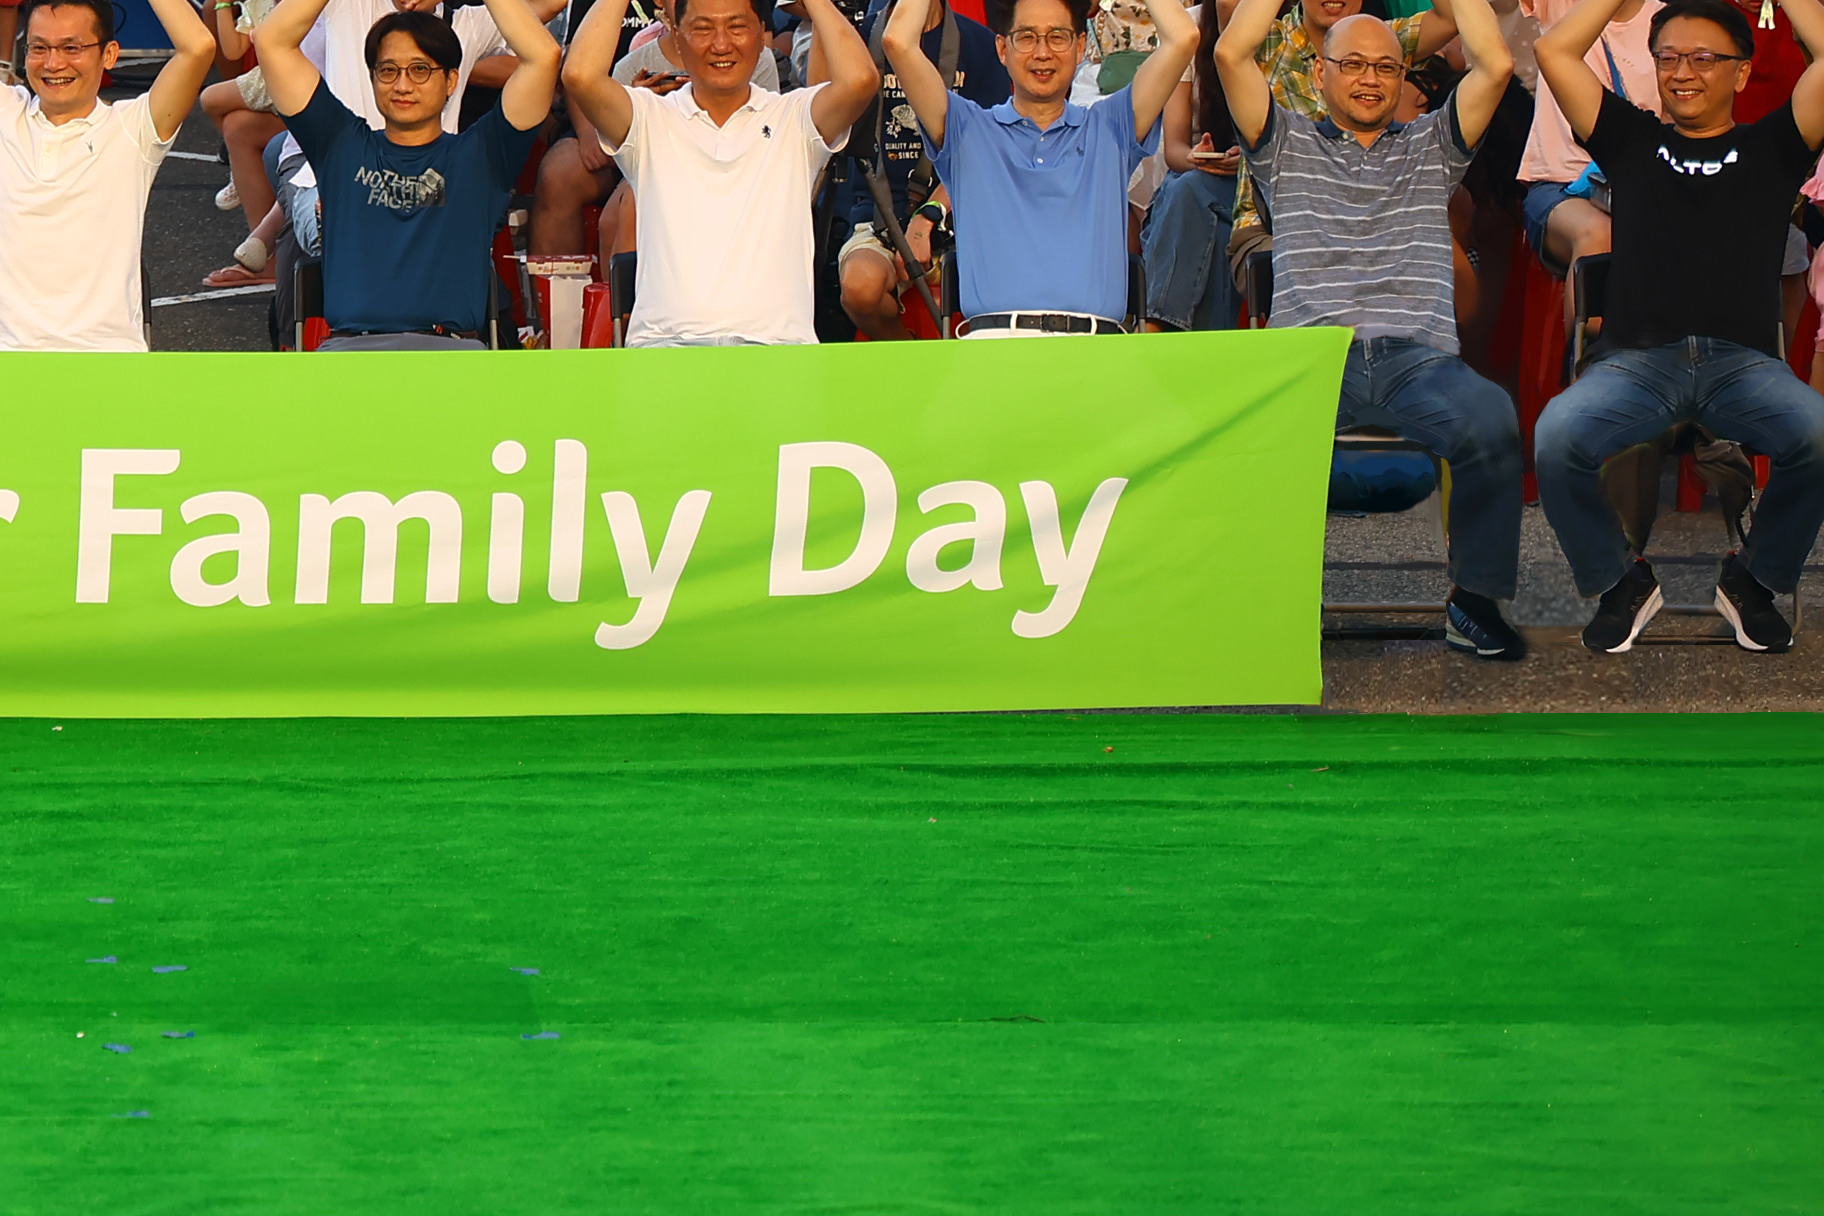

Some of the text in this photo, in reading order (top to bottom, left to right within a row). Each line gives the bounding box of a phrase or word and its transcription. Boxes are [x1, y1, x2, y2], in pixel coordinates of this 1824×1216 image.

[898, 151, 919, 159] SINCE
[367, 188, 414, 213] FACE
[76, 439, 712, 650] Family
[769, 442, 1128, 639] Day
